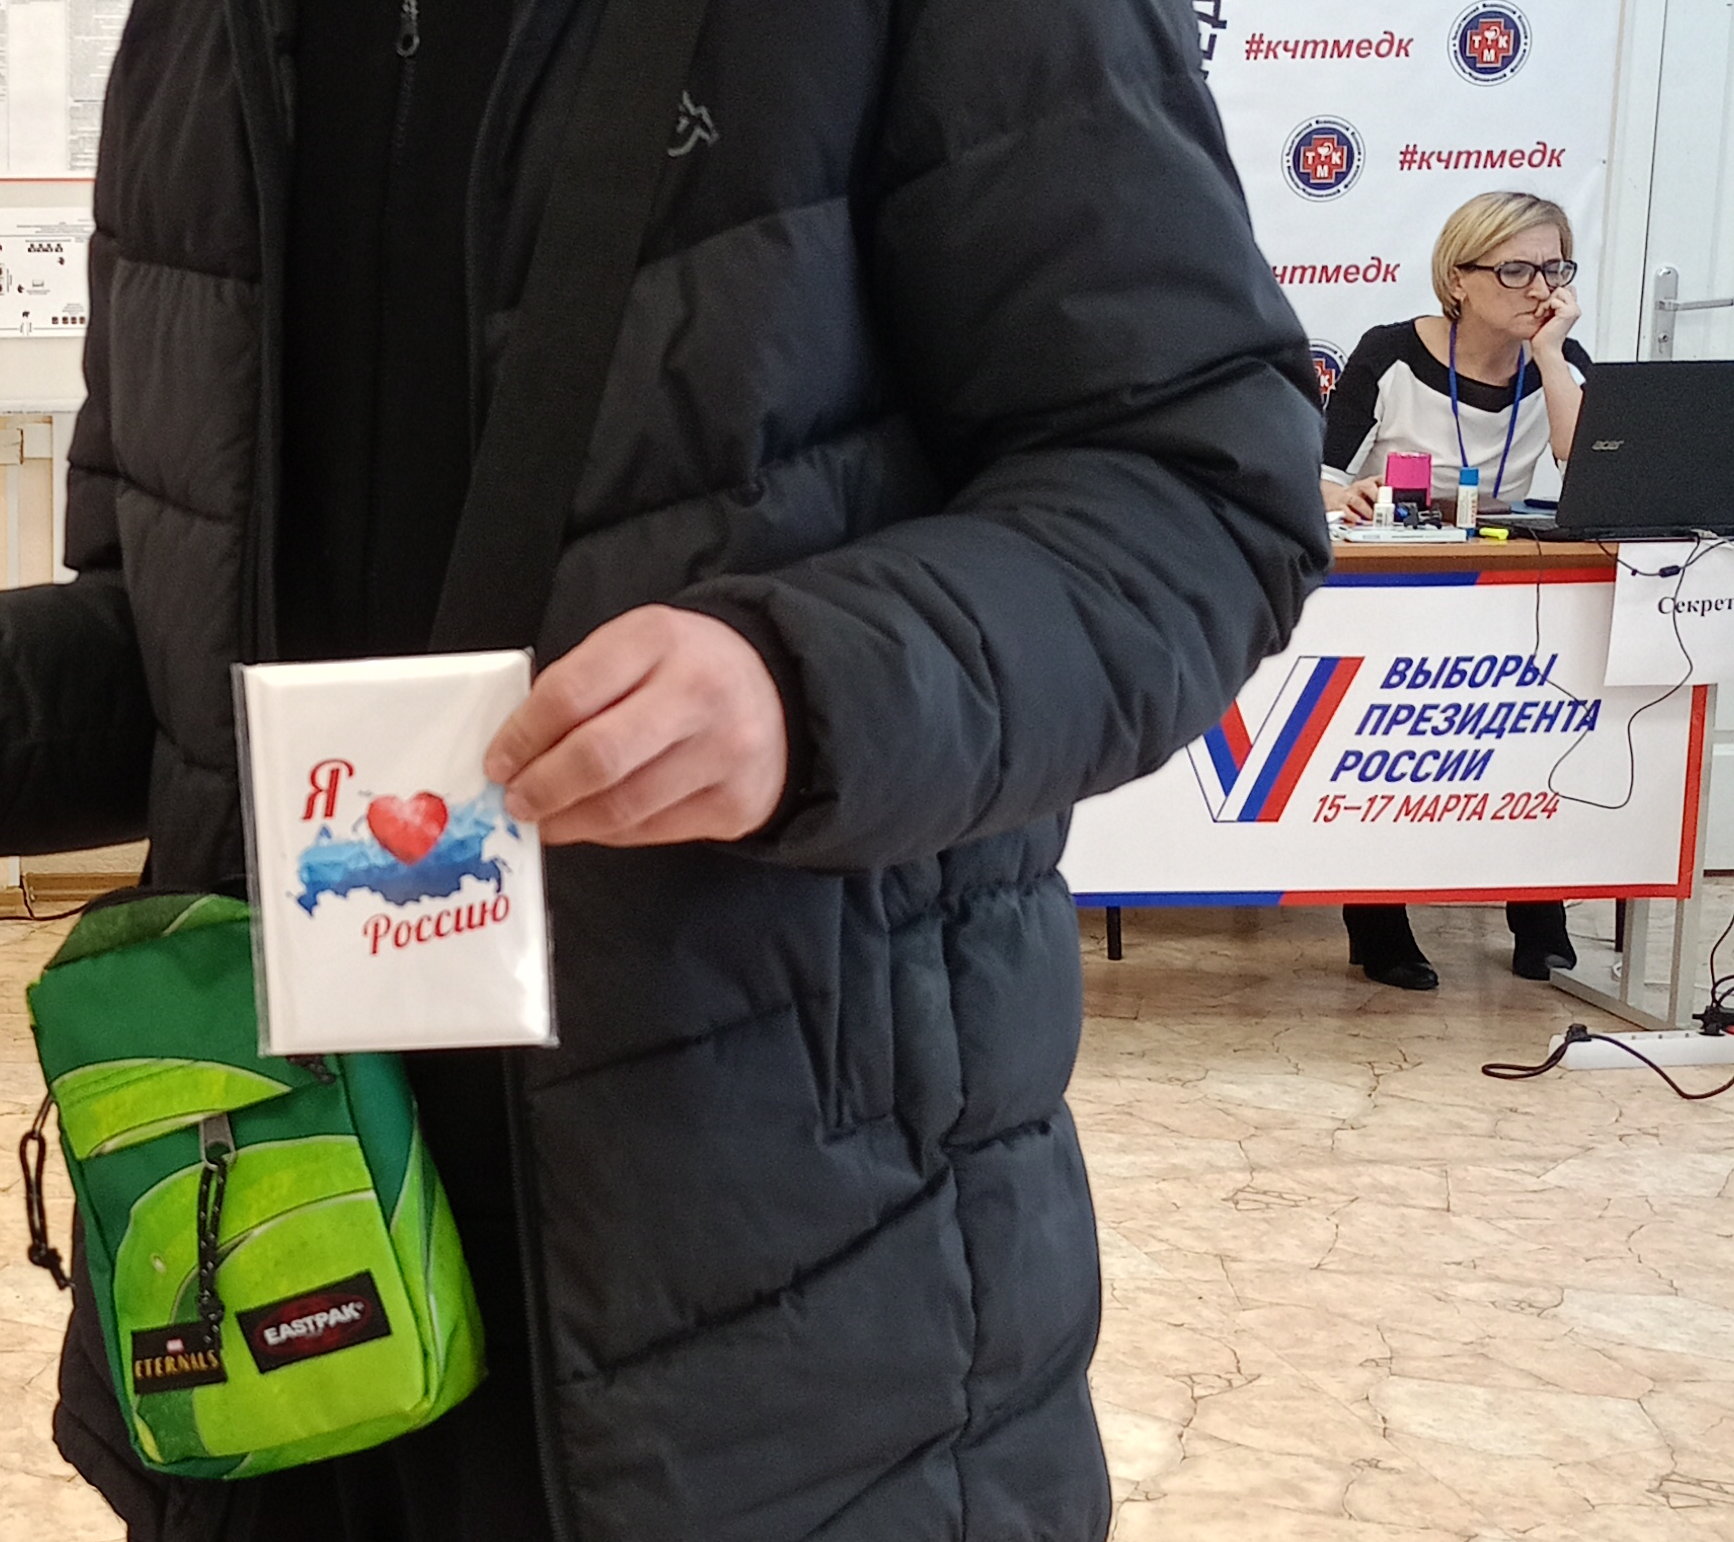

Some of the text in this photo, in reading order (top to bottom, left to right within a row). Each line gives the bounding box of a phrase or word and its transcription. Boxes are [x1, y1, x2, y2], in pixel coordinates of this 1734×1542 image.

[1244, 31, 1413, 61] #кчтмедк
[1399, 142, 1565, 171] #кчтмедк
[1272, 256, 1401, 285] чтмедк
[1381, 654, 1559, 689] ВЫБОРЫ
[1355, 699, 1604, 739] ПРЕЗИДЕНТА
[1330, 748, 1496, 784] РОССИИ
[302, 758, 354, 821] Я
[1394, 793, 1488, 824] МАРТА
[1491, 791, 1561, 821] 2024
[363, 894, 511, 955] Россию
[134, 1350, 219, 1379] ETERNALS
